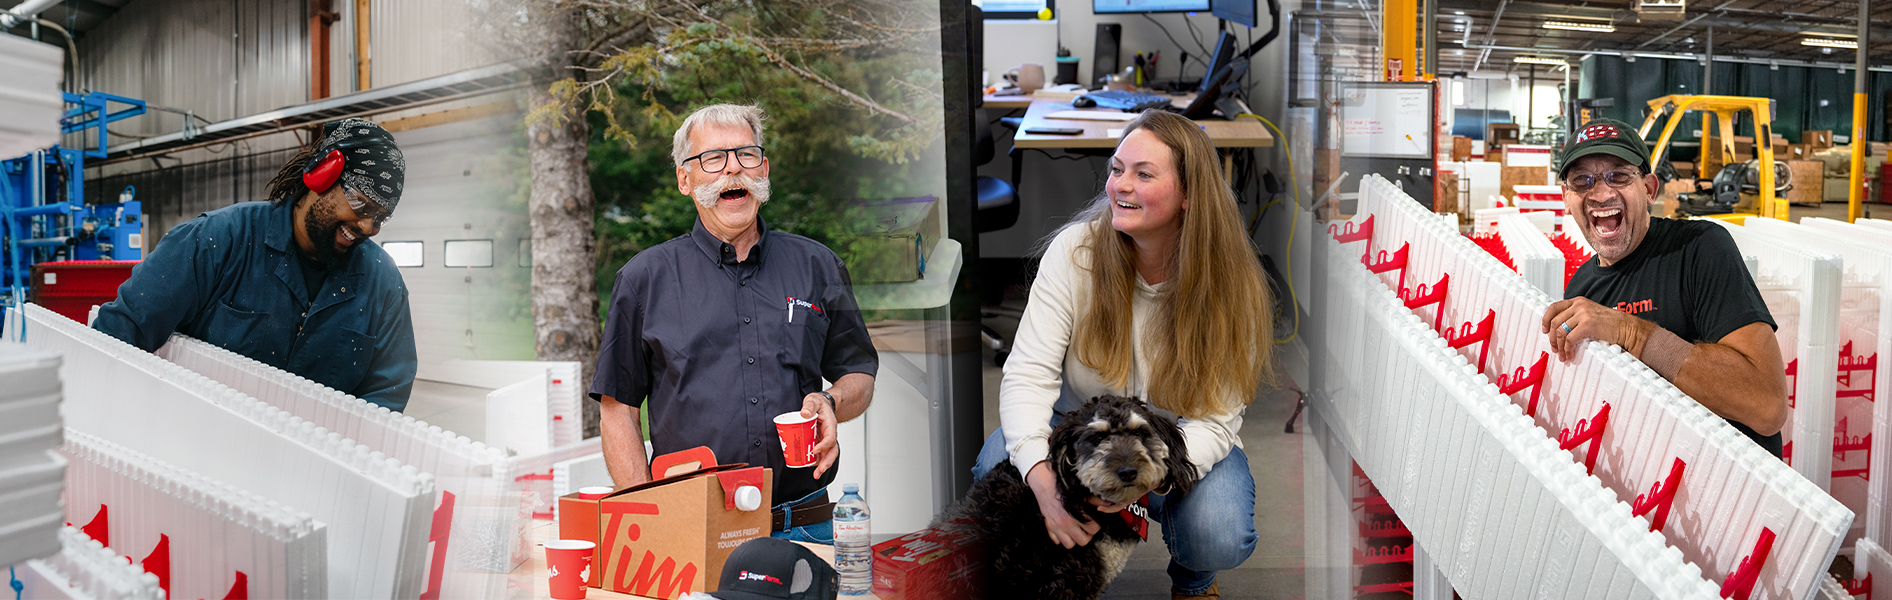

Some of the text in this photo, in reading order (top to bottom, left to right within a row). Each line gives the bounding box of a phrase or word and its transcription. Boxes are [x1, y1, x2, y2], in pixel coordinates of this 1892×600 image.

[1613, 299, 1653, 314] Form
[720, 527, 759, 539] ALWAYS FRESH
[601, 501, 698, 600] Tim
[748, 572, 779, 582] SuperForm
